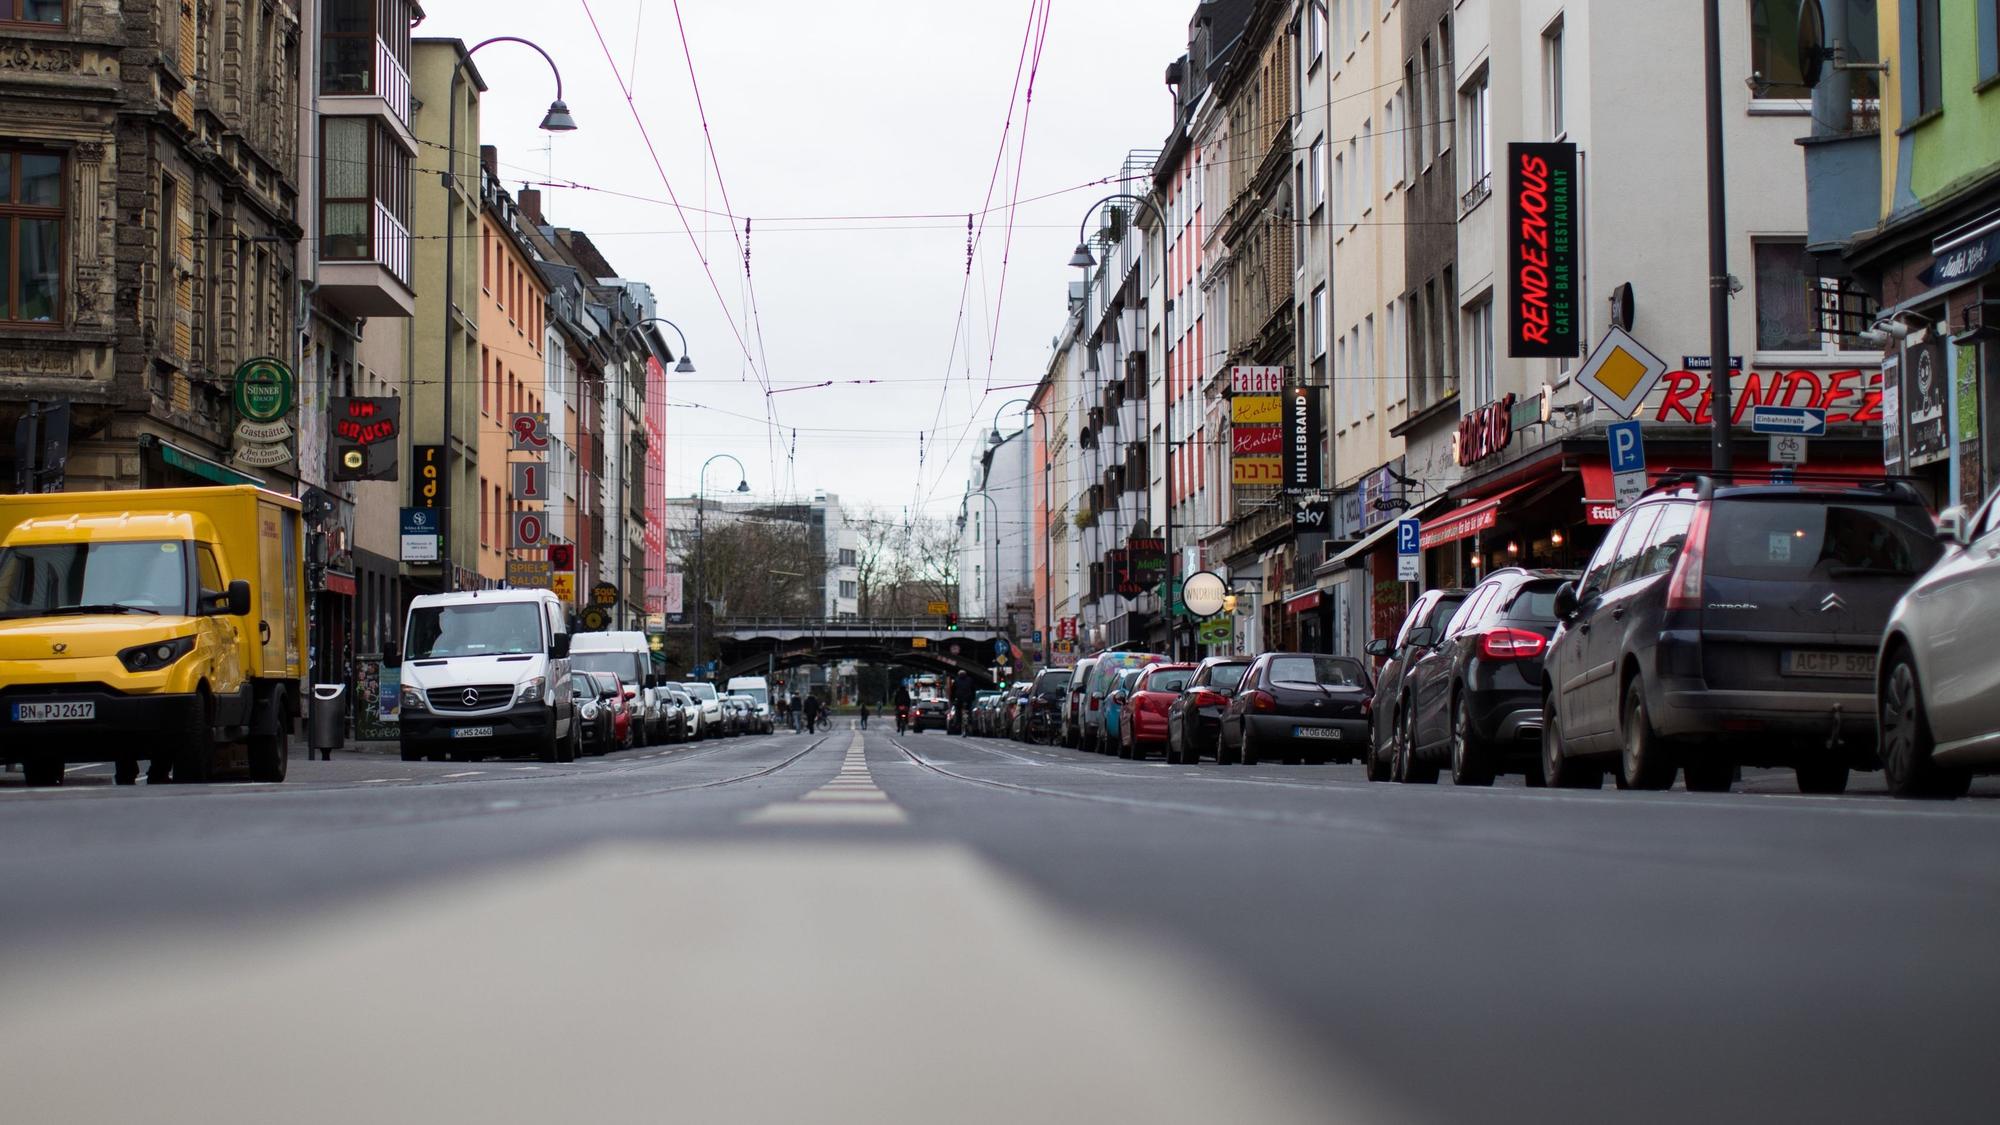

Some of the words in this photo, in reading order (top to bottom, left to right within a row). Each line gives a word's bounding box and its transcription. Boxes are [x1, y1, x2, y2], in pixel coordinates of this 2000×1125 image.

[1553, 169, 1569, 253] RESTAURANT
[1521, 153, 1550, 345] RENDEZVOUS
[1555, 264, 1569, 290] BAR
[1553, 304, 1569, 335] CAFÉ
[1233, 367, 1284, 391] Falafel
[1234, 399, 1283, 421] Habibi
[1757, 415, 1805, 425] Einbahnstraße
[240, 424, 286, 438] Gaststätte
[1234, 429, 1283, 451] Habibi
[1296, 395, 1308, 483] HILLEBRAND
[246, 448, 259, 457] Bei
[260, 448, 279, 457] Oma
[1616, 428, 1634, 466] P
[239, 452, 287, 464] Kleinmann
[1296, 509, 1325, 526] sky
[1402, 524, 1414, 550] P
[510, 563, 540, 573] SPIEL
[510, 576, 548, 585] SALON
[595, 587, 616, 596] SOUL
[1796, 653, 1817, 670] AC
[1829, 654, 1840, 670] P
[20, 705, 37, 719] BN
[45, 704, 60, 718] PJ
[63, 703, 93, 718] 2617
